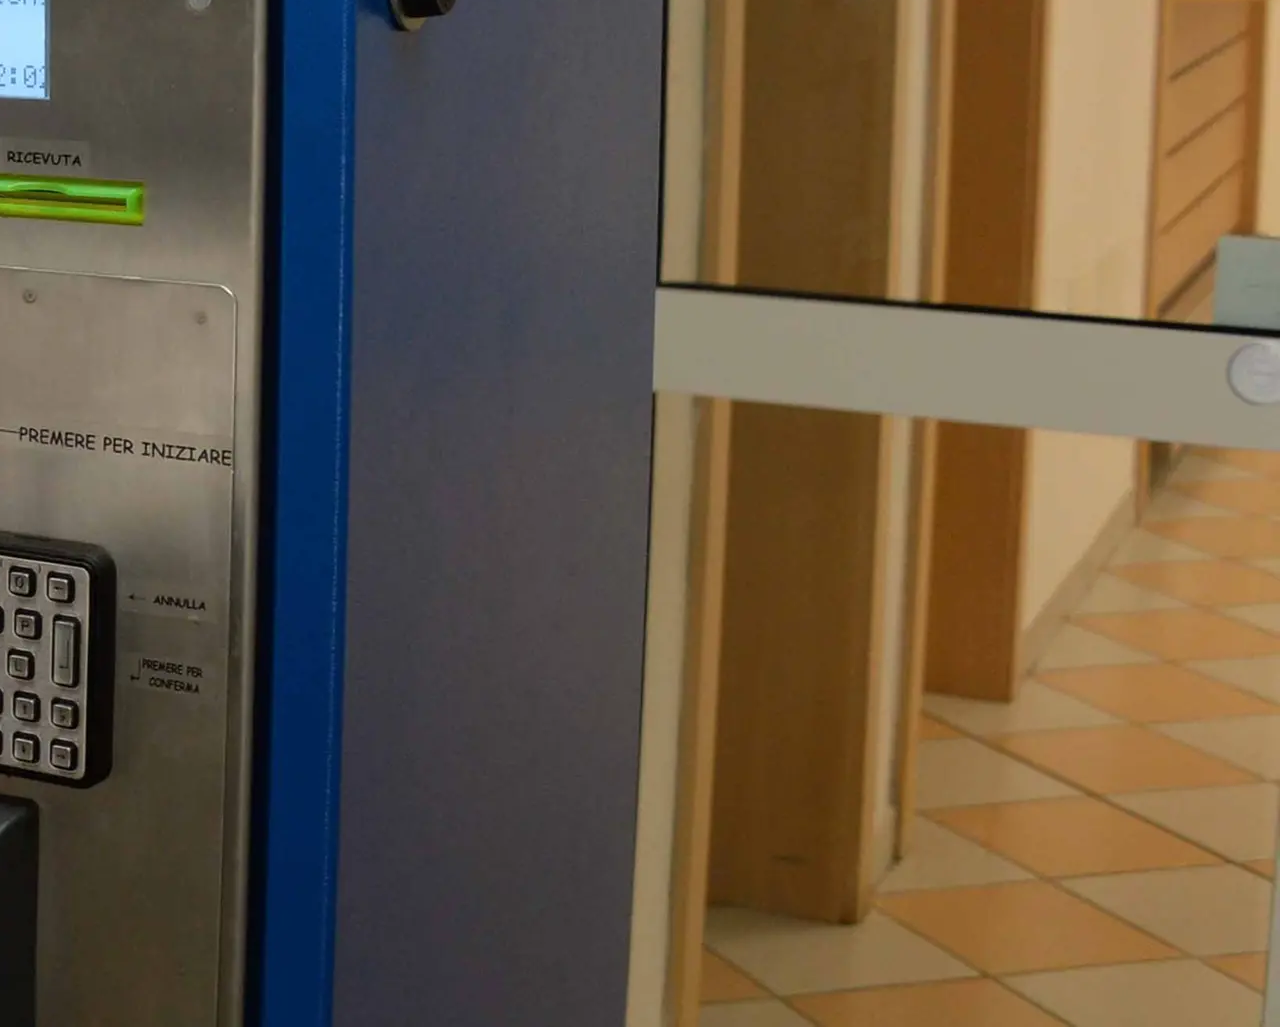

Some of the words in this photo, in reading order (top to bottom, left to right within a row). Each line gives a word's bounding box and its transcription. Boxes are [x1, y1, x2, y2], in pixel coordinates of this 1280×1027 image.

[6, 150, 82, 168] RICEVUTA
[19, 426, 96, 451] PREMERE
[103, 437, 135, 454] PER
[141, 441, 233, 467] INIZIARE
[153, 595, 206, 611] ANNULLA
[142, 658, 183, 675] PREMERE
[186, 666, 203, 678] PER
[149, 676, 200, 694] CONFERMA
